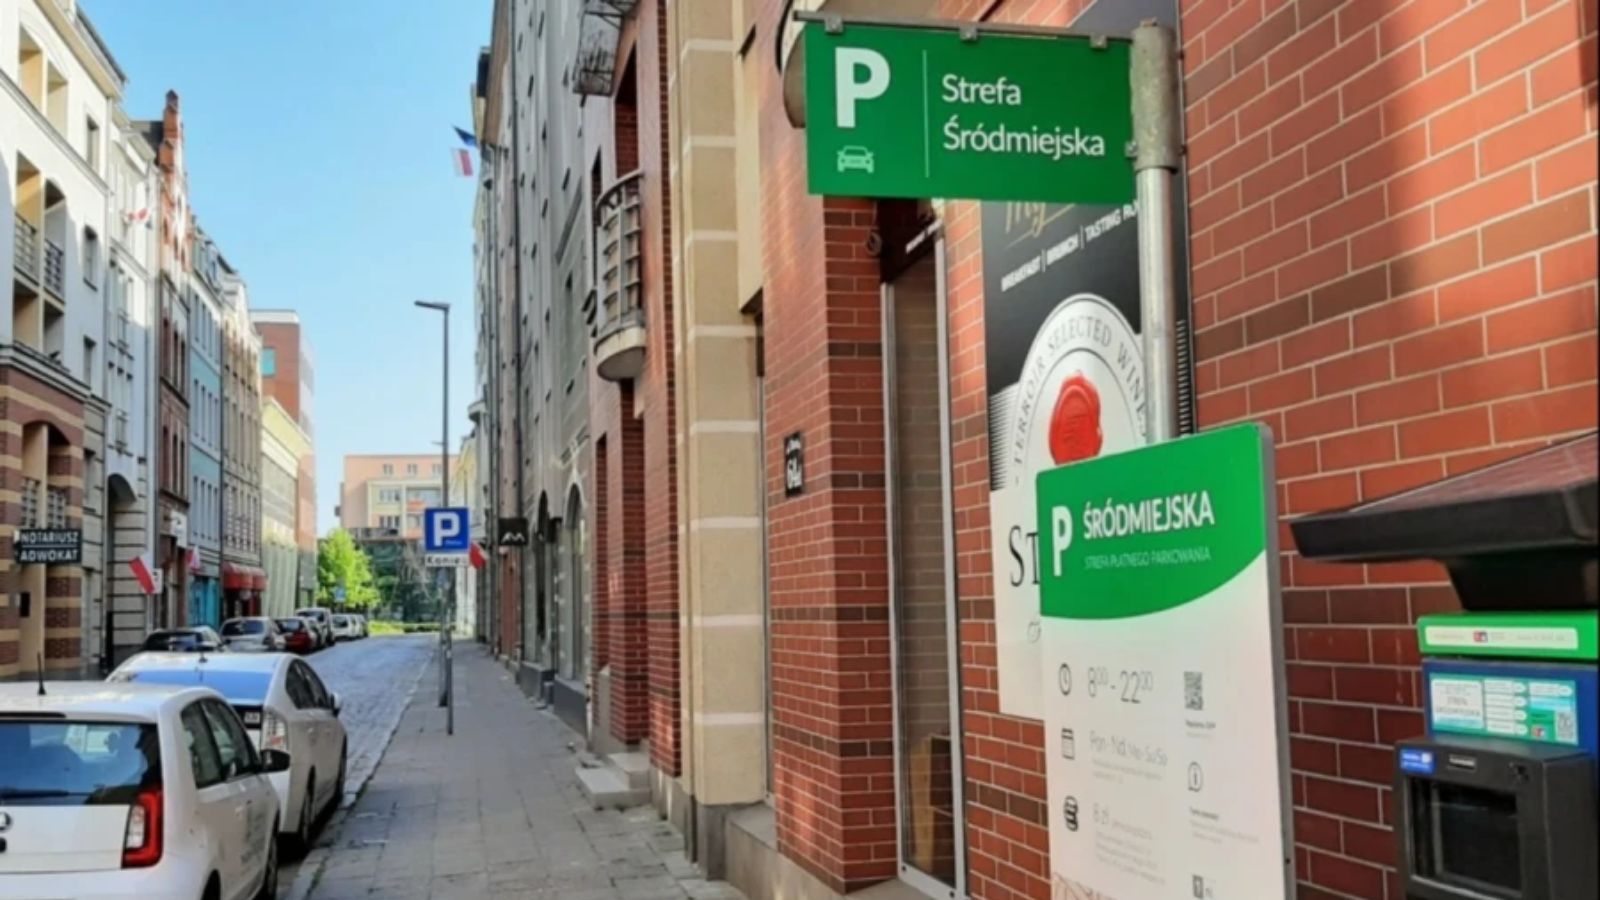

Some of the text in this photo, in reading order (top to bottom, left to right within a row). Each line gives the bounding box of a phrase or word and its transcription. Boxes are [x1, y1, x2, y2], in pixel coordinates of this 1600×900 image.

[835, 47, 891, 128] P
[942, 74, 1021, 105] Strefa
[943, 115, 1105, 160] Śródmiejska
[1084, 208, 1122, 242] TASTING
[1048, 316, 1112, 356] SELECTED
[433, 512, 460, 547] P
[1083, 490, 1215, 540] ŚRÓDMIEJSKA
[20, 550, 79, 561] ADWOKAT
[21, 532, 79, 544] NOTARIUSZ
[1052, 505, 1073, 576] P
[1084, 546, 1212, 570] STREFA PŁATNEGO PARKOWANIA
